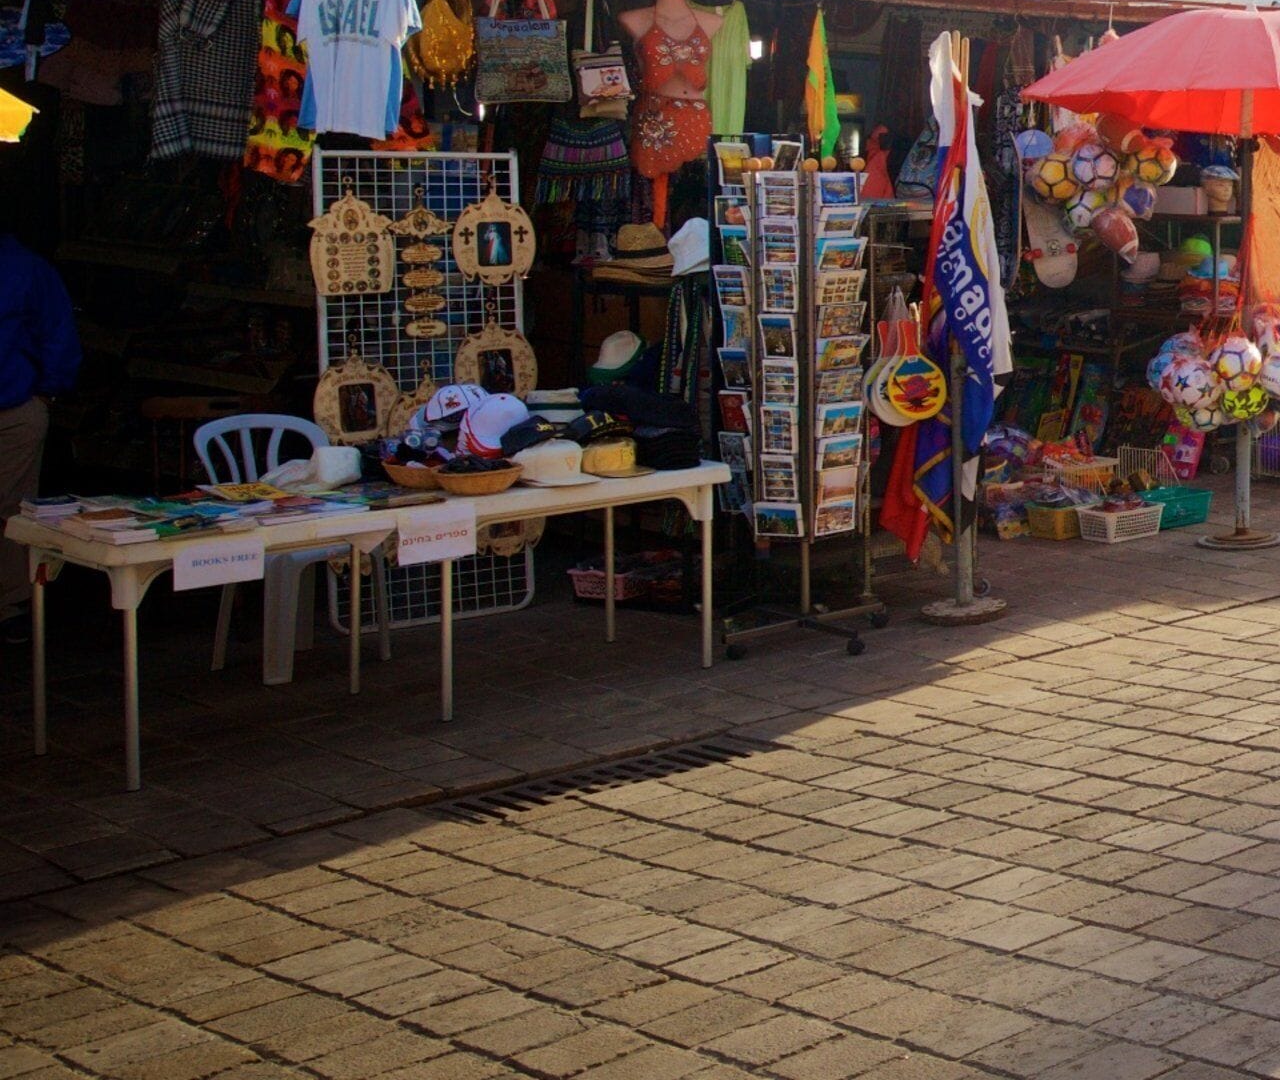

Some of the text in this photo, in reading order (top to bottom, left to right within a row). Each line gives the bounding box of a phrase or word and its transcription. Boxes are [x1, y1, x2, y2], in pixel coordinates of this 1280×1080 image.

[490, 17, 550, 32] Jerusalem
[402, 529, 468, 546] ספרים בחינם
[192, 552, 259, 568] BOOKS FREE
